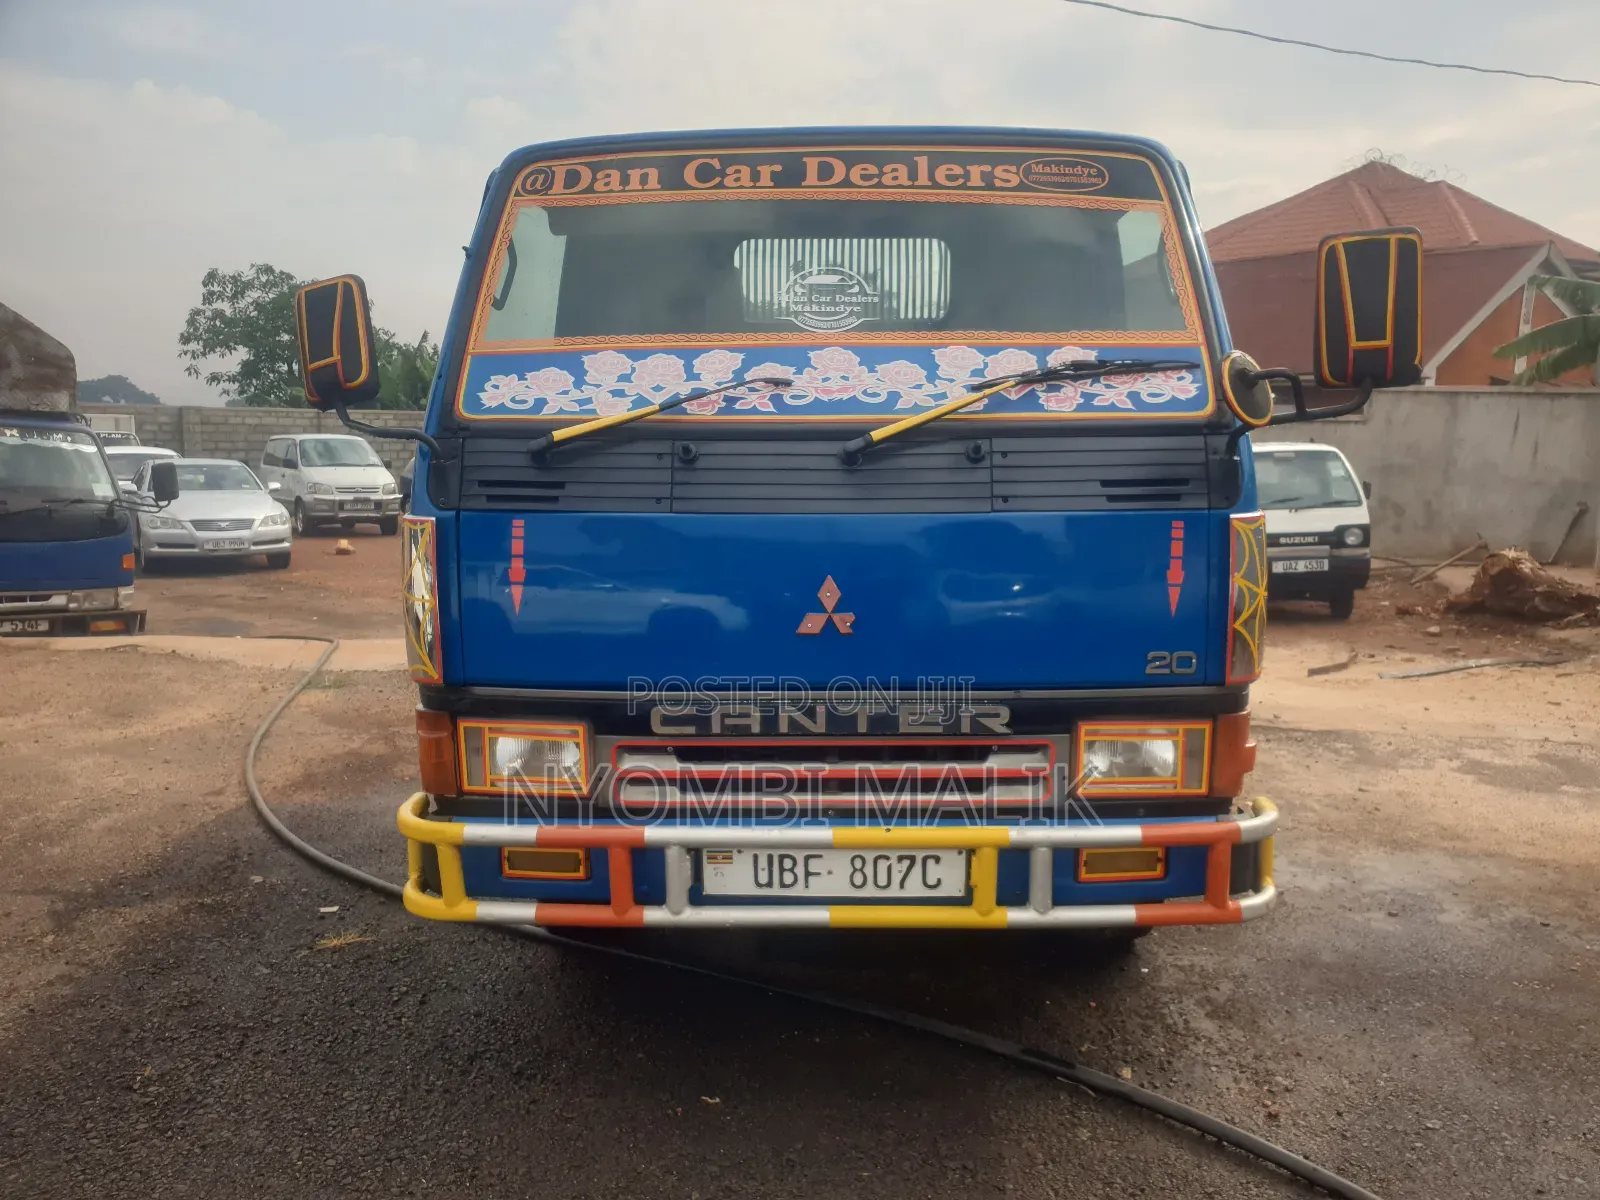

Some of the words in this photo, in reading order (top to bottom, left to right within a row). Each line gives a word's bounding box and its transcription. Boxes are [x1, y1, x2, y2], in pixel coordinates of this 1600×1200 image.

[517, 164, 661, 196] @Dan
[683, 157, 782, 187] Car
[801, 156, 1020, 187] Dealers
[1031, 163, 1098, 176] Makindye
[811, 294, 833, 303] Car
[835, 295, 879, 303] Dealers
[790, 304, 862, 314] Makindye
[1279, 536, 1318, 544] SUZUKI
[1282, 561, 1299, 571] UAZ
[1145, 651, 1197, 674] 20
[650, 705, 1013, 735] CANTER
[753, 853, 823, 889] UBF
[849, 854, 942, 889] 807C
